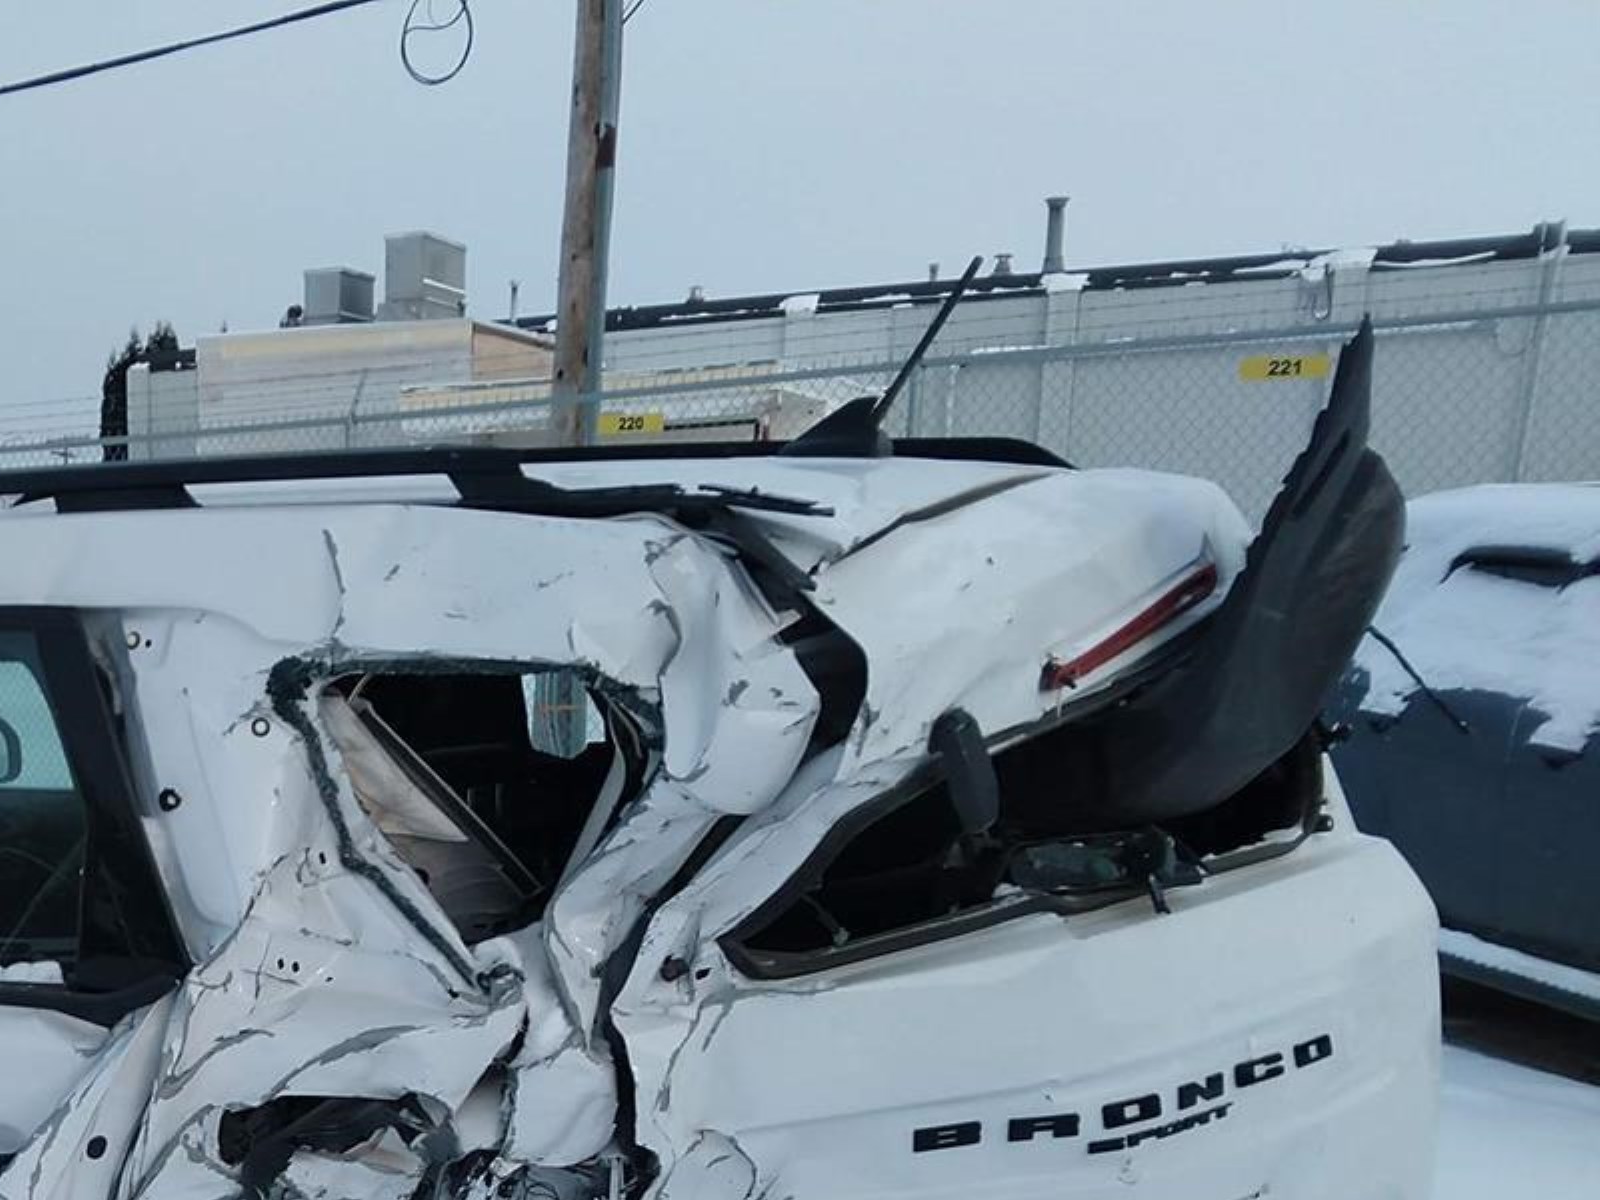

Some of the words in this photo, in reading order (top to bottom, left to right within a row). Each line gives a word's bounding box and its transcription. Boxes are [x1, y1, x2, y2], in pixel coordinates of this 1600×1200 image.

[1268, 359, 1302, 376] 221
[618, 416, 644, 430] 220
[913, 1034, 1332, 1153] BRONCO
[1087, 1102, 1233, 1154] SPORT
